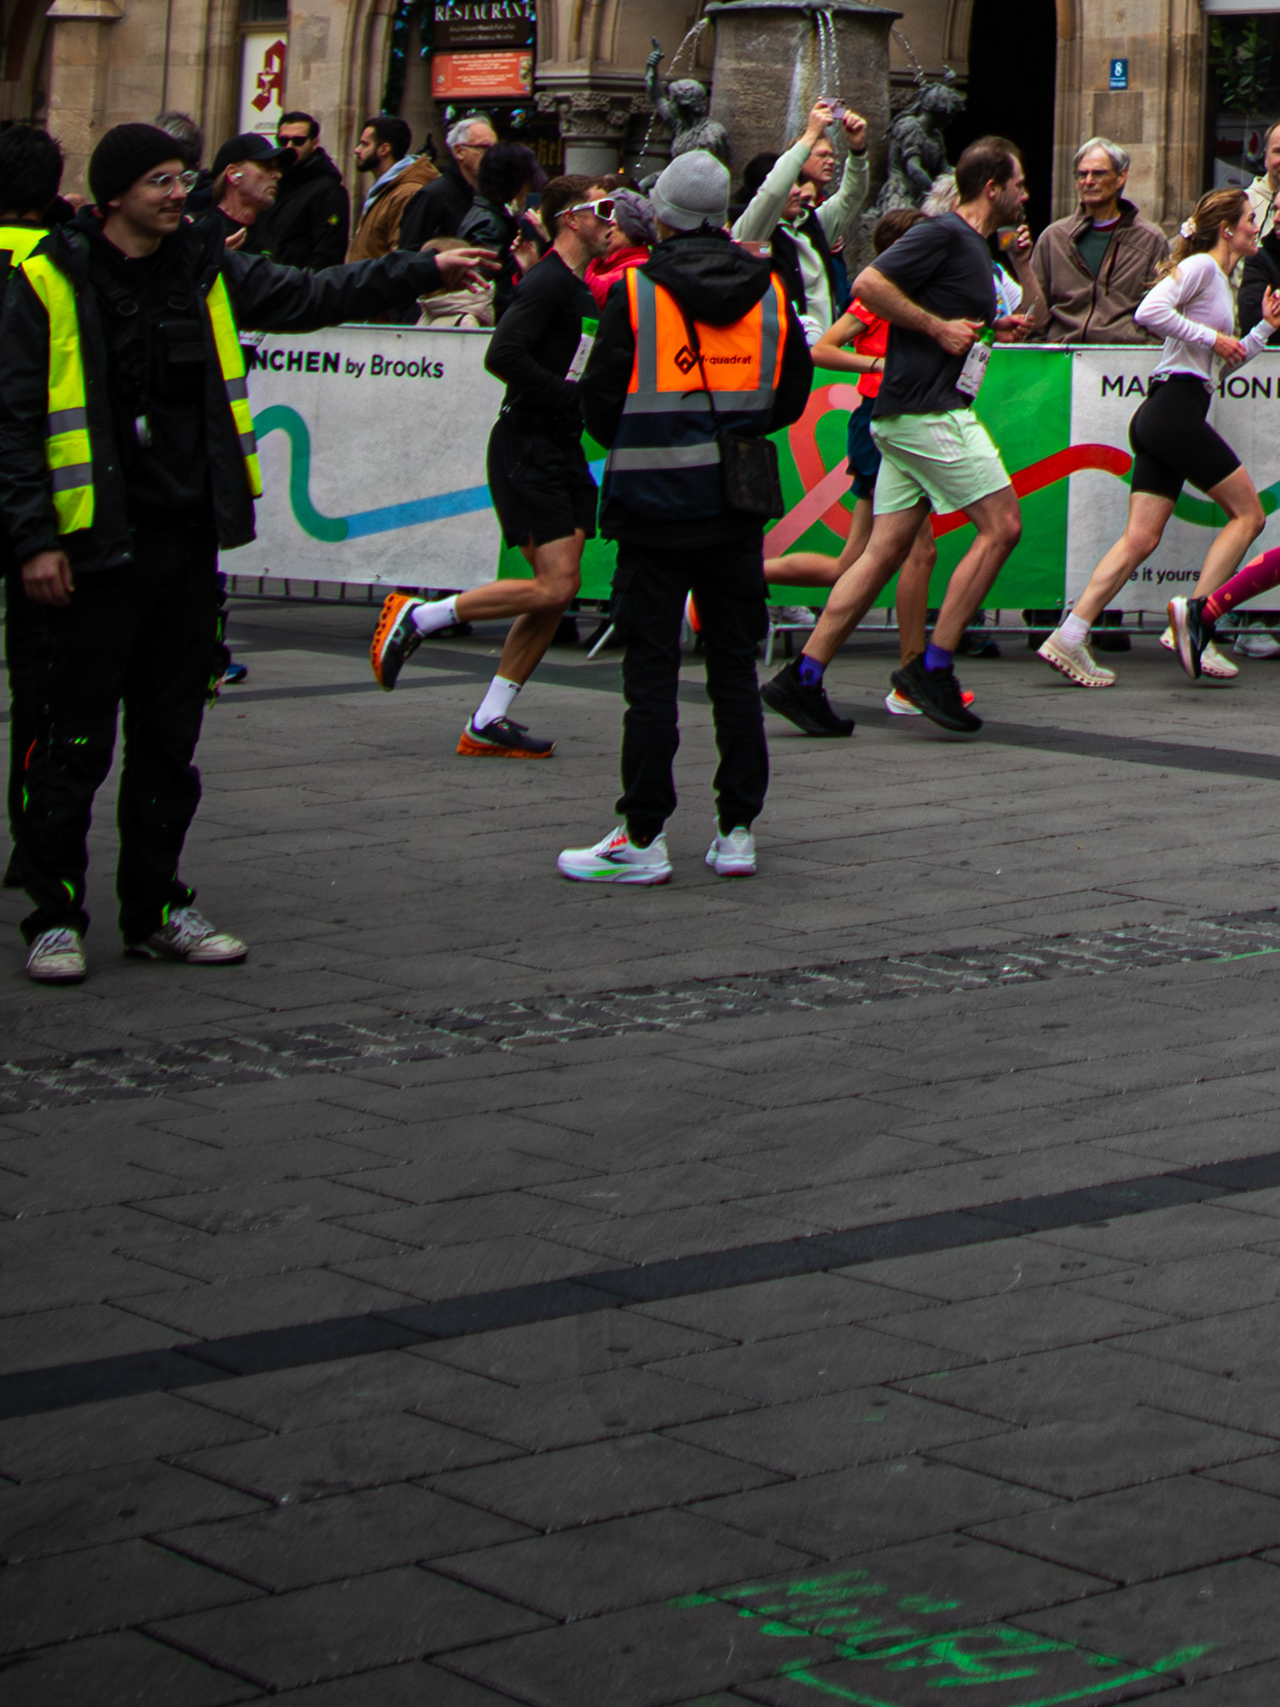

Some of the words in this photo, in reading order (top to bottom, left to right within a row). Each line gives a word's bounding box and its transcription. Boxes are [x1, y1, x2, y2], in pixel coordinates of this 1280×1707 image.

[345, 358, 365, 379] by
[370, 353, 444, 379] Brooks
[1142, 568, 1153, 582] it
[1156, 569, 1200, 584] yours
